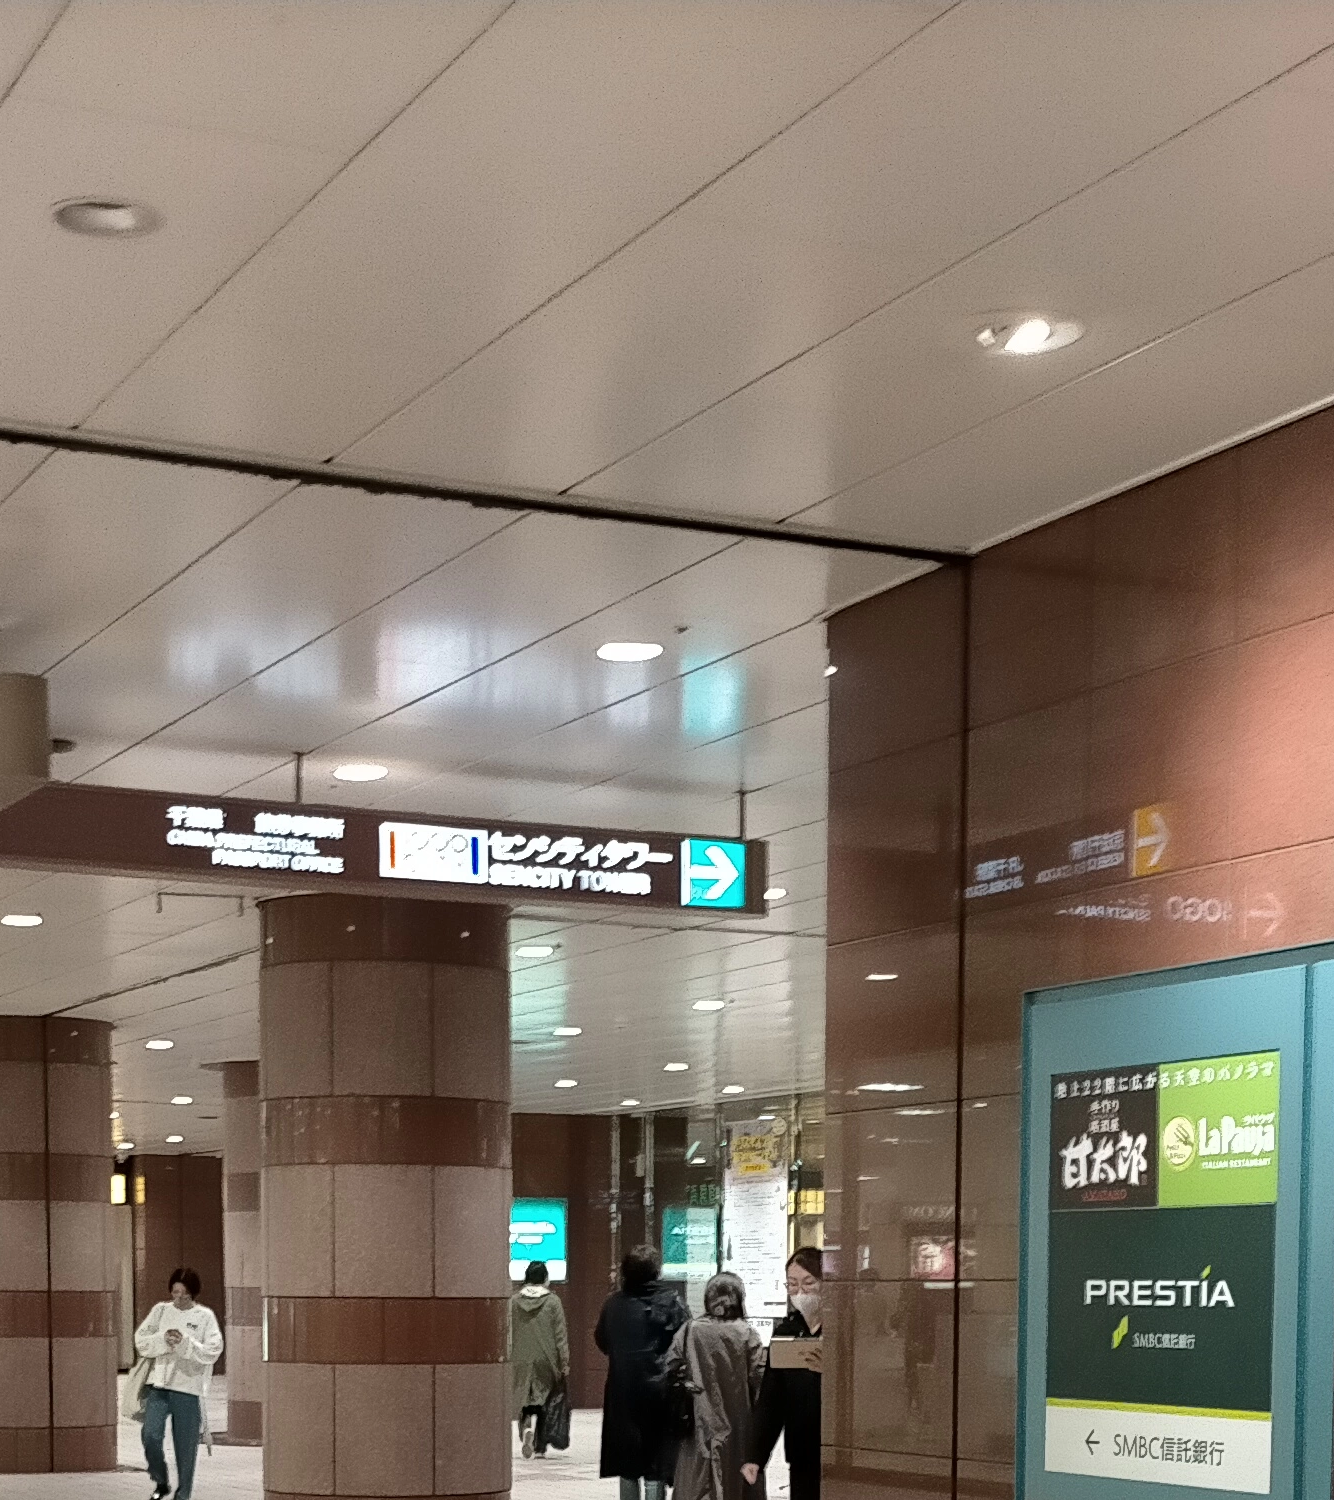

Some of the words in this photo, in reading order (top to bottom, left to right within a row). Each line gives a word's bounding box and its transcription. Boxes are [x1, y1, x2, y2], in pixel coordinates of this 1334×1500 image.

[488, 831, 673, 869] センシティタワー
[1058, 1131, 1148, 1189] 甘太郎
[1113, 1434, 1225, 1466] SMBC信託銀行
